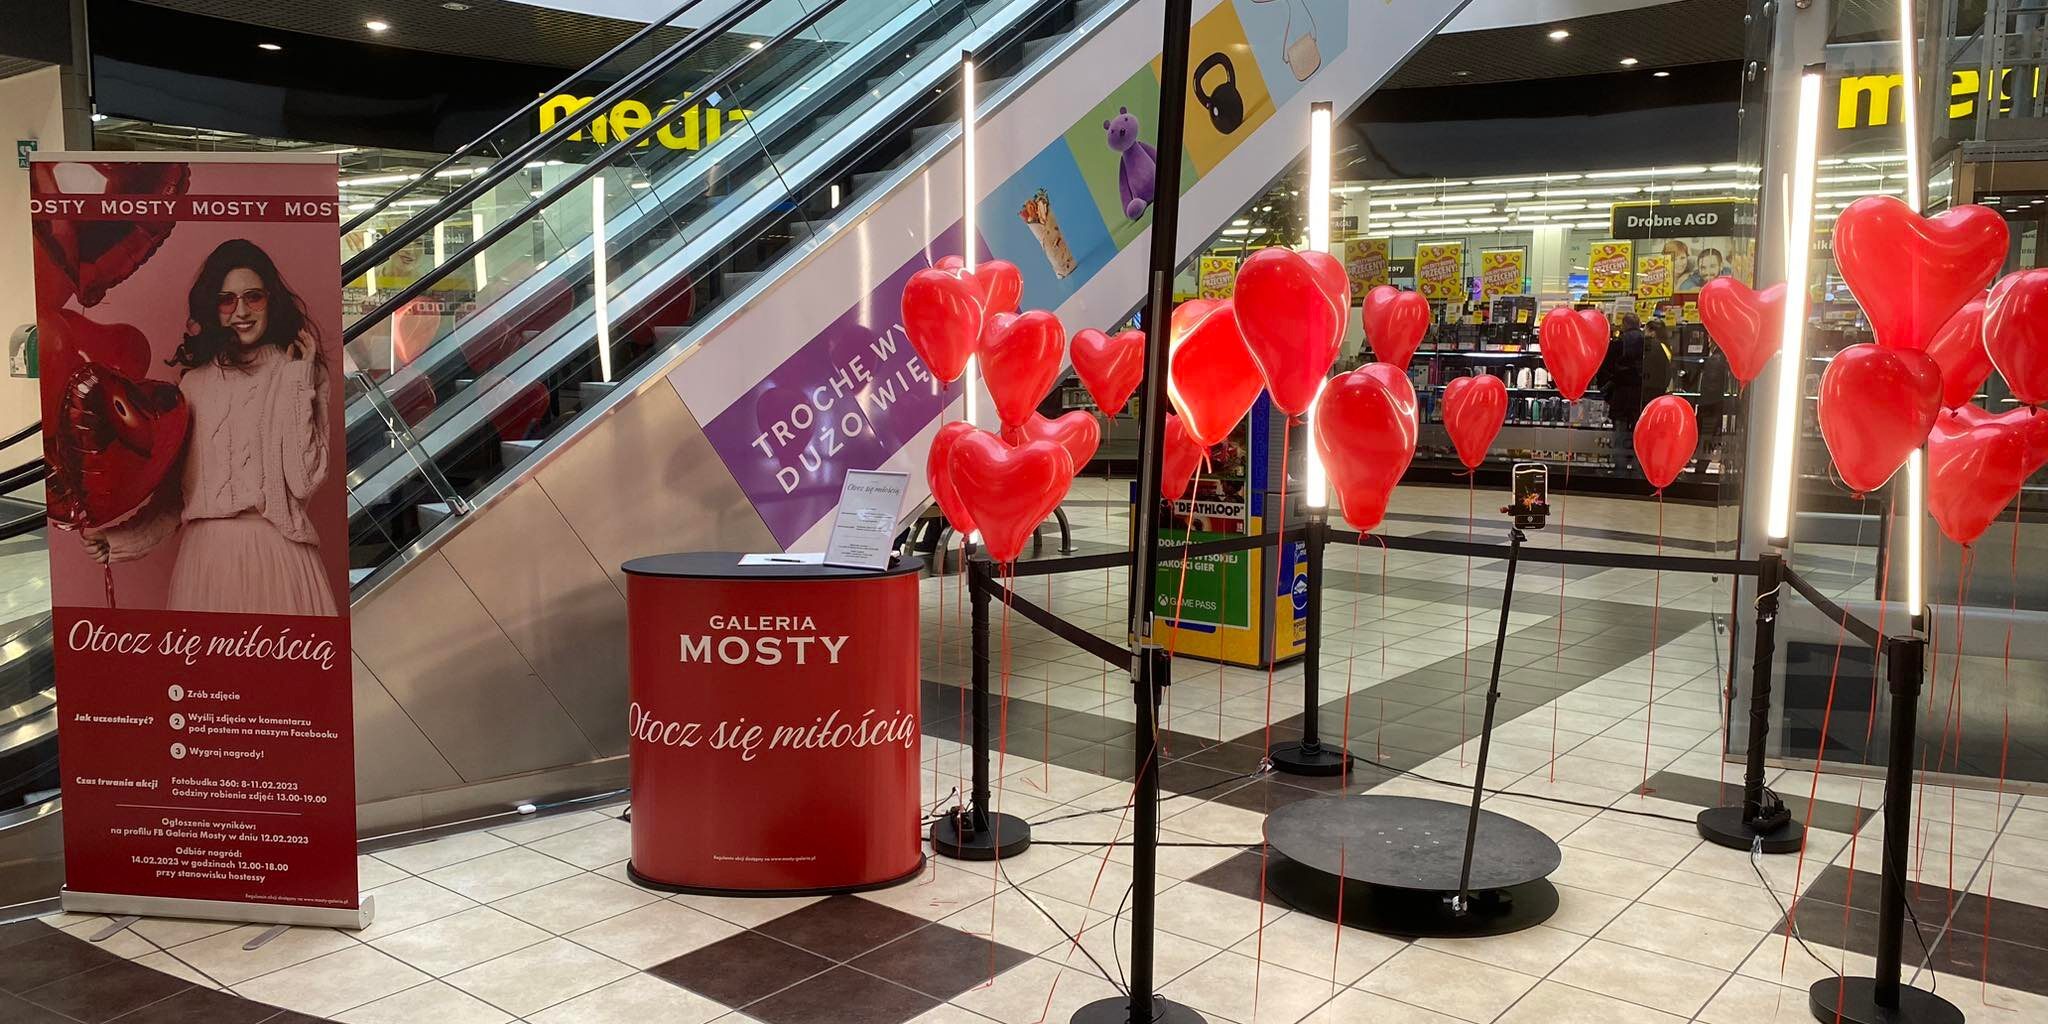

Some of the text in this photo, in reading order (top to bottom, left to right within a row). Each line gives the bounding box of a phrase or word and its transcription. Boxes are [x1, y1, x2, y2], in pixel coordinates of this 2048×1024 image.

[101, 200, 176, 215] MOSTY
[192, 201, 269, 216] MOSTY
[1627, 215, 1681, 228] Drobne
[1684, 213, 1719, 226] AGD
[752, 355, 873, 459] TROCHĘ
[775, 355, 930, 494] DUŻO WIĘ
[1194, 562, 1215, 572] GIER
[1170, 597, 1217, 610] GME PASS
[709, 615, 816, 631] GALERIA
[69, 619, 336, 671] Otocz się miłością
[679, 634, 850, 665] MOSTY
[187, 690, 240, 701] Zrób zdjęcie
[74, 713, 154, 726] Jak uczestniczyć?
[188, 713, 214, 724] Wyślij
[216, 714, 246, 724] zdjęcie
[259, 716, 311, 726] komentarzu
[188, 724, 206, 734] pod
[207, 726, 240, 735] postem
[255, 729, 289, 738] naszym
[290, 729, 338, 739] Facebooku
[628, 702, 915, 762] Otocz się miłością
[189, 747, 264, 759] Wygraj nagrody!
[76, 777, 158, 789] Czas trwania akcji
[172, 777, 298, 790] Fotobudka 360: 8-11.02.2023
[172, 788, 327, 803] Godziny robienia zdjęć: 13.00-19.00
[161, 817, 256, 830] Ogłoszenie wyników:
[124, 827, 152, 837] profilu
[154, 828, 164, 836] FB
[165, 829, 198, 838] Galeria
[200, 831, 226, 841] Mosty
[239, 833, 258, 841] dniu
[261, 834, 309, 844] 12.02.2023
[175, 846, 242, 858] Odbiór nagród:
[131, 855, 179, 866] 14.02.2023
[191, 859, 235, 869] godzinach
[238, 861, 289, 871] 12.00-18.00
[156, 870, 266, 883] przy stanowisku hostessy
